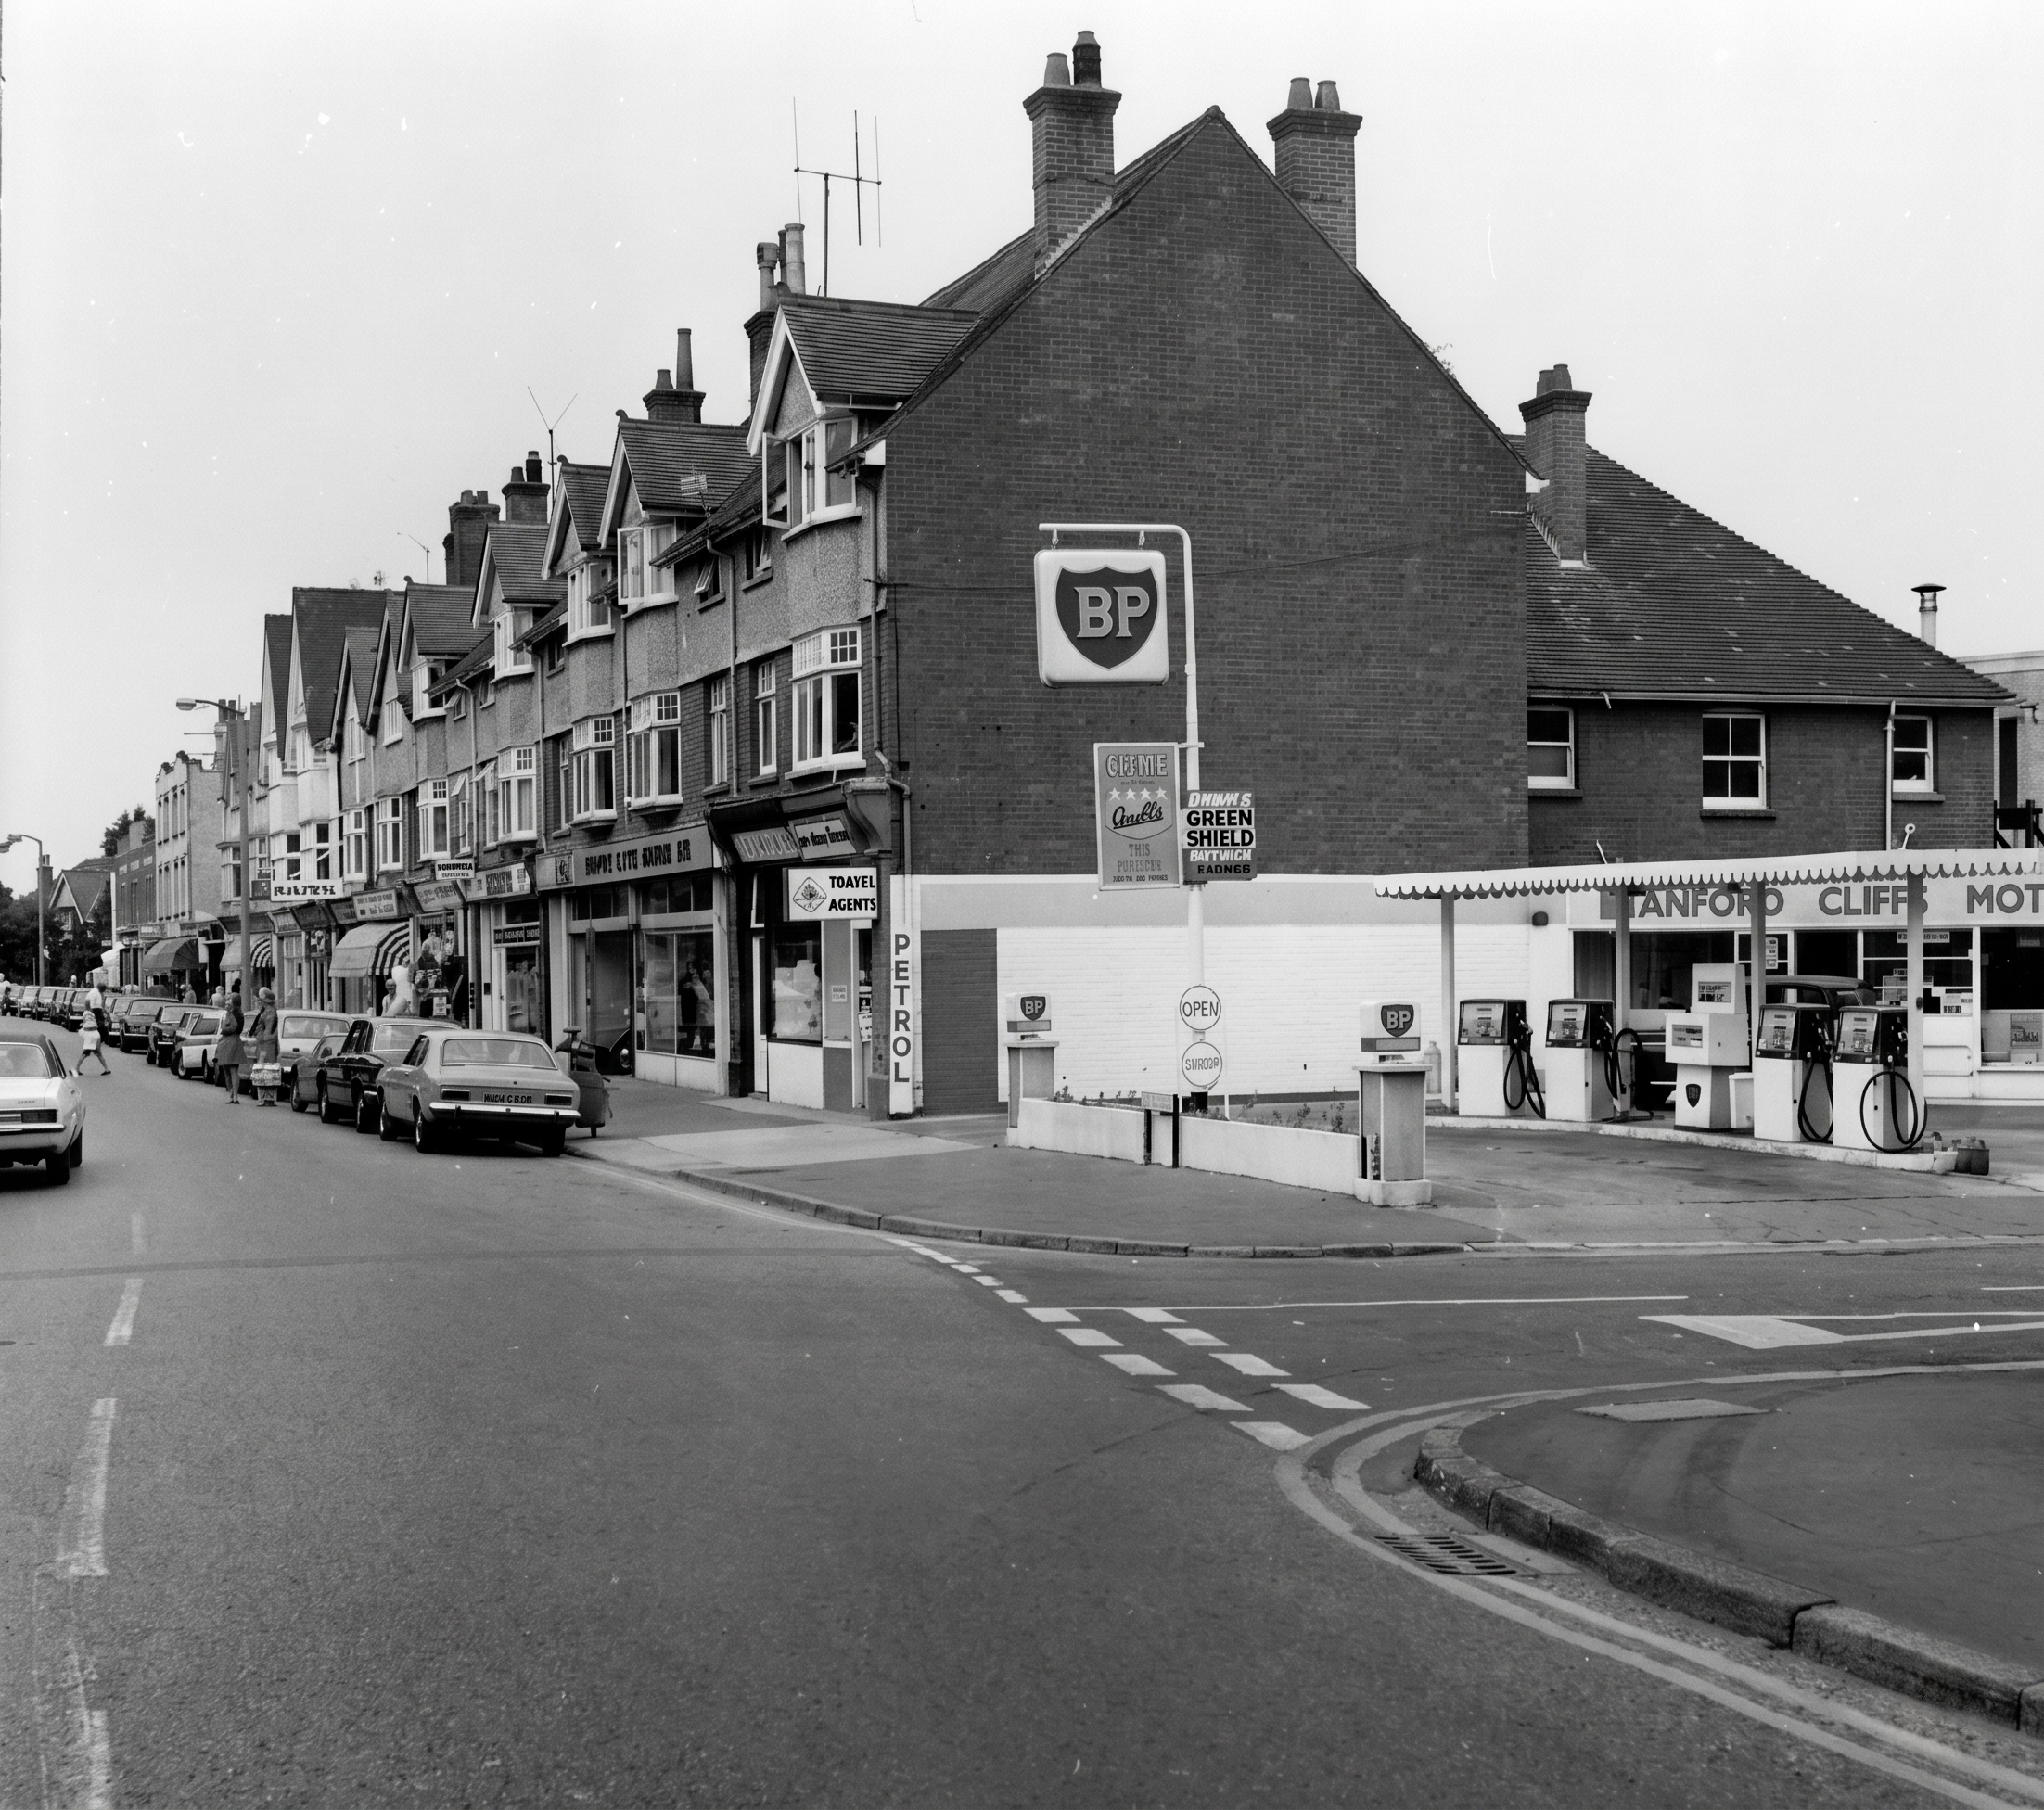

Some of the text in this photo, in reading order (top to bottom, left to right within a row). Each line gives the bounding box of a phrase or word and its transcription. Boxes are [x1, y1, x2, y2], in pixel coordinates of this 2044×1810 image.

[1074, 586, 1150, 638] BP
[1186, 809, 1252, 826] GREEN
[1186, 830, 1254, 847] SHIELD
[828, 898, 876, 911] AGENTS
[892, 934, 911, 1083] PETROL
[1025, 1001, 1043, 1015] BP
[1182, 1001, 1219, 1017] OPEN
[1386, 1011, 1411, 1029] BP
